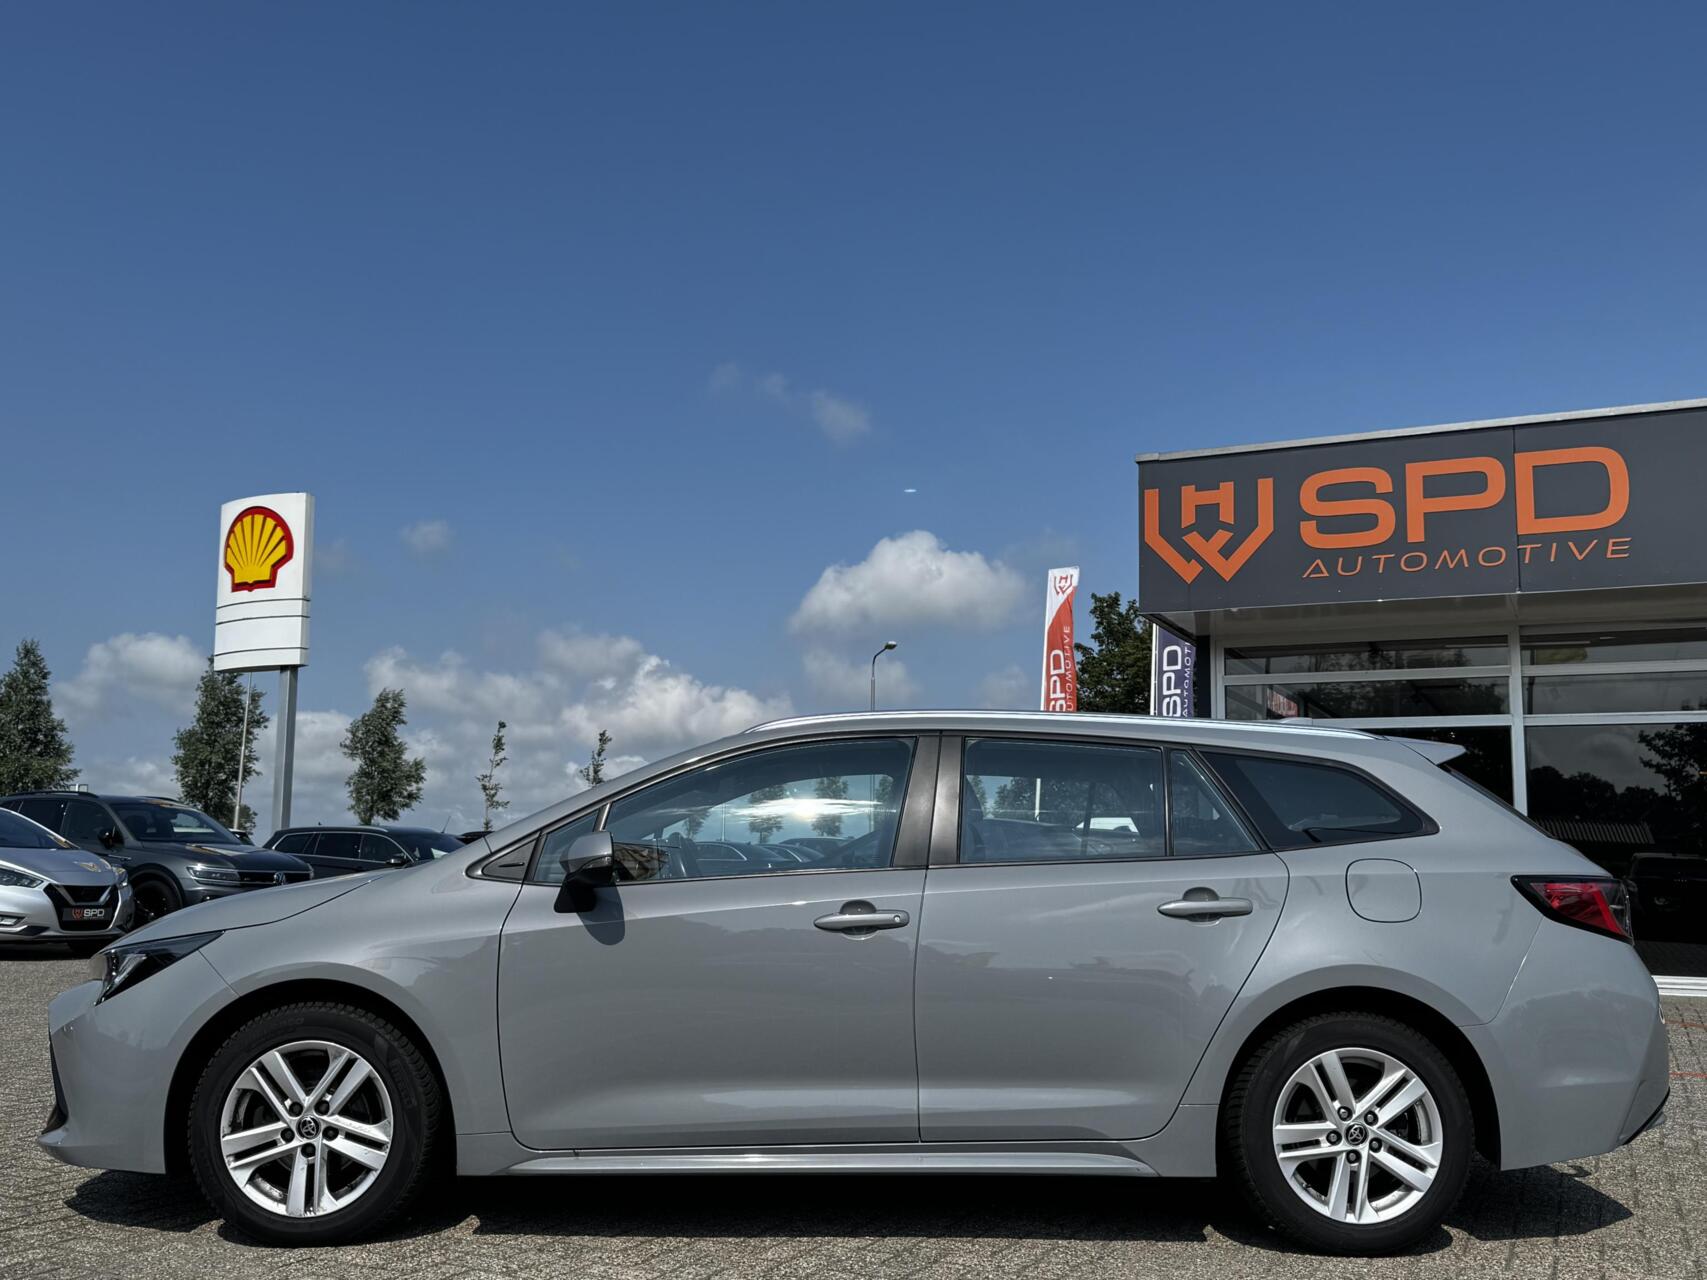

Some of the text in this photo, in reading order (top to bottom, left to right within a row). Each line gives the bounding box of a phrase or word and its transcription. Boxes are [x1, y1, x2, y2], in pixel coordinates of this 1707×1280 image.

[1300, 447, 1630, 549] SPD
[1302, 537, 1633, 578] AUTOMOTIVE
[1063, 625, 1074, 711] UTOMOTIVE
[1162, 645, 1182, 717] SPD
[83, 908, 105, 917] SPD
